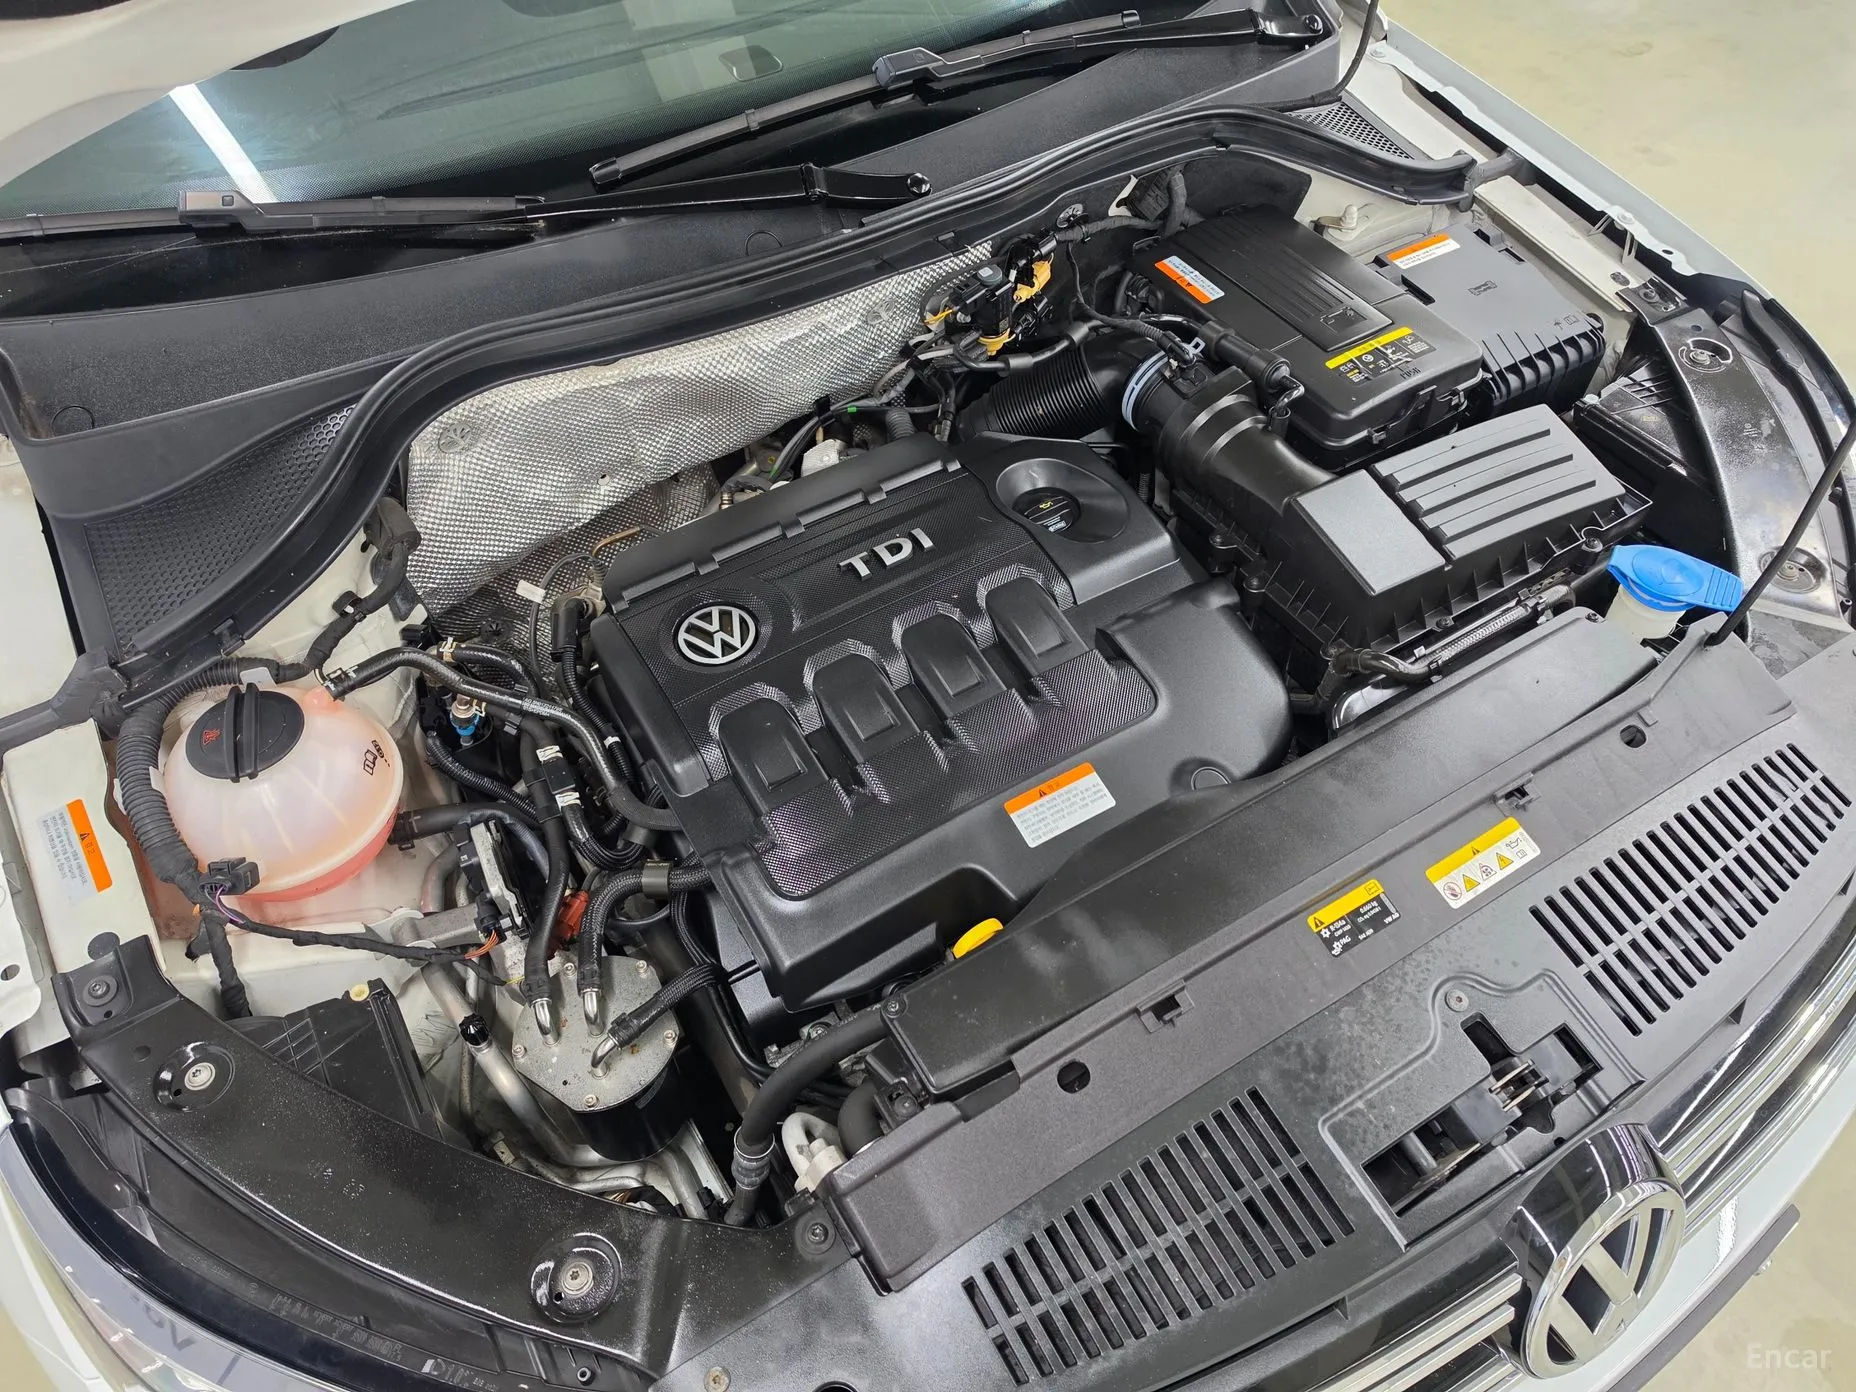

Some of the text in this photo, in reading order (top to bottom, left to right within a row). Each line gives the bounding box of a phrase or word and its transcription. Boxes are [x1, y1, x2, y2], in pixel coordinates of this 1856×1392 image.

[1399, 367, 1421, 380] PUSH
[837, 527, 936, 582] TDI
[677, 604, 757, 665] VW
[1339, 935, 1351, 945] PAG
